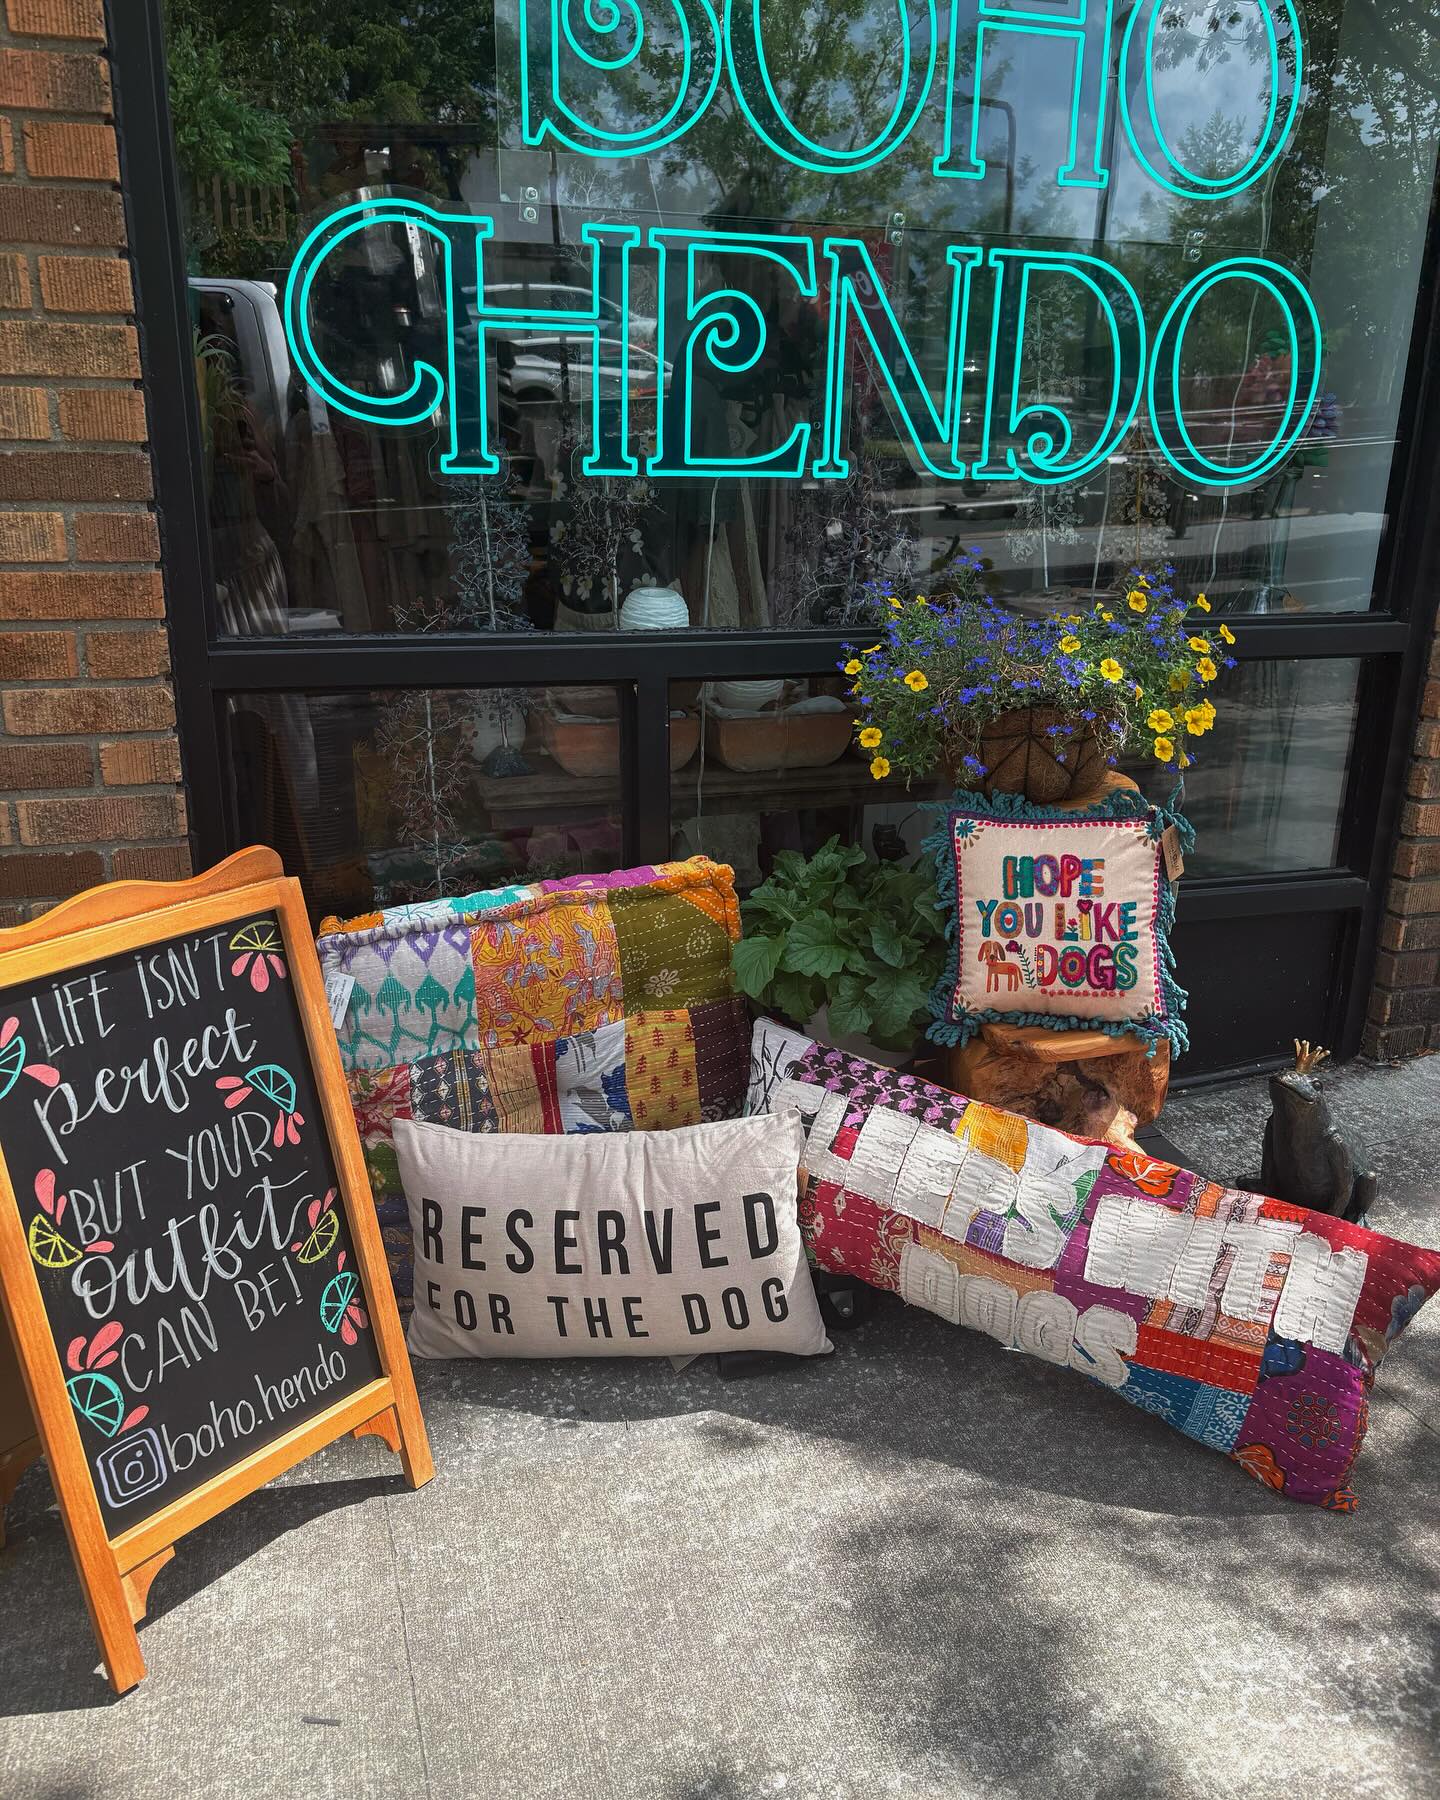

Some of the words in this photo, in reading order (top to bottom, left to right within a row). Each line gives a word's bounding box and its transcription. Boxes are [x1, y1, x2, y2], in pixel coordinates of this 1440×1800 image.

[976, 899, 1044, 939] YOU
[1054, 899, 1139, 942] LIKE
[1003, 854, 1105, 900] HOPE
[1035, 941, 1139, 990] DOGS
[33, 1008, 258, 1165] perfect
[68, 1160, 147, 1245] BUT
[165, 1111, 273, 1200] YOUR
[422, 1192, 779, 1275] RESERVED
[1083, 1194, 1369, 1355] WITH
[121, 1301, 219, 1393] CAN
[233, 1255, 304, 1332] BE!
[427, 1280, 515, 1336] FOR
[547, 1296, 650, 1339] THE
[681, 1277, 789, 1335] DOG
[160, 1343, 347, 1473] boho.hendo
